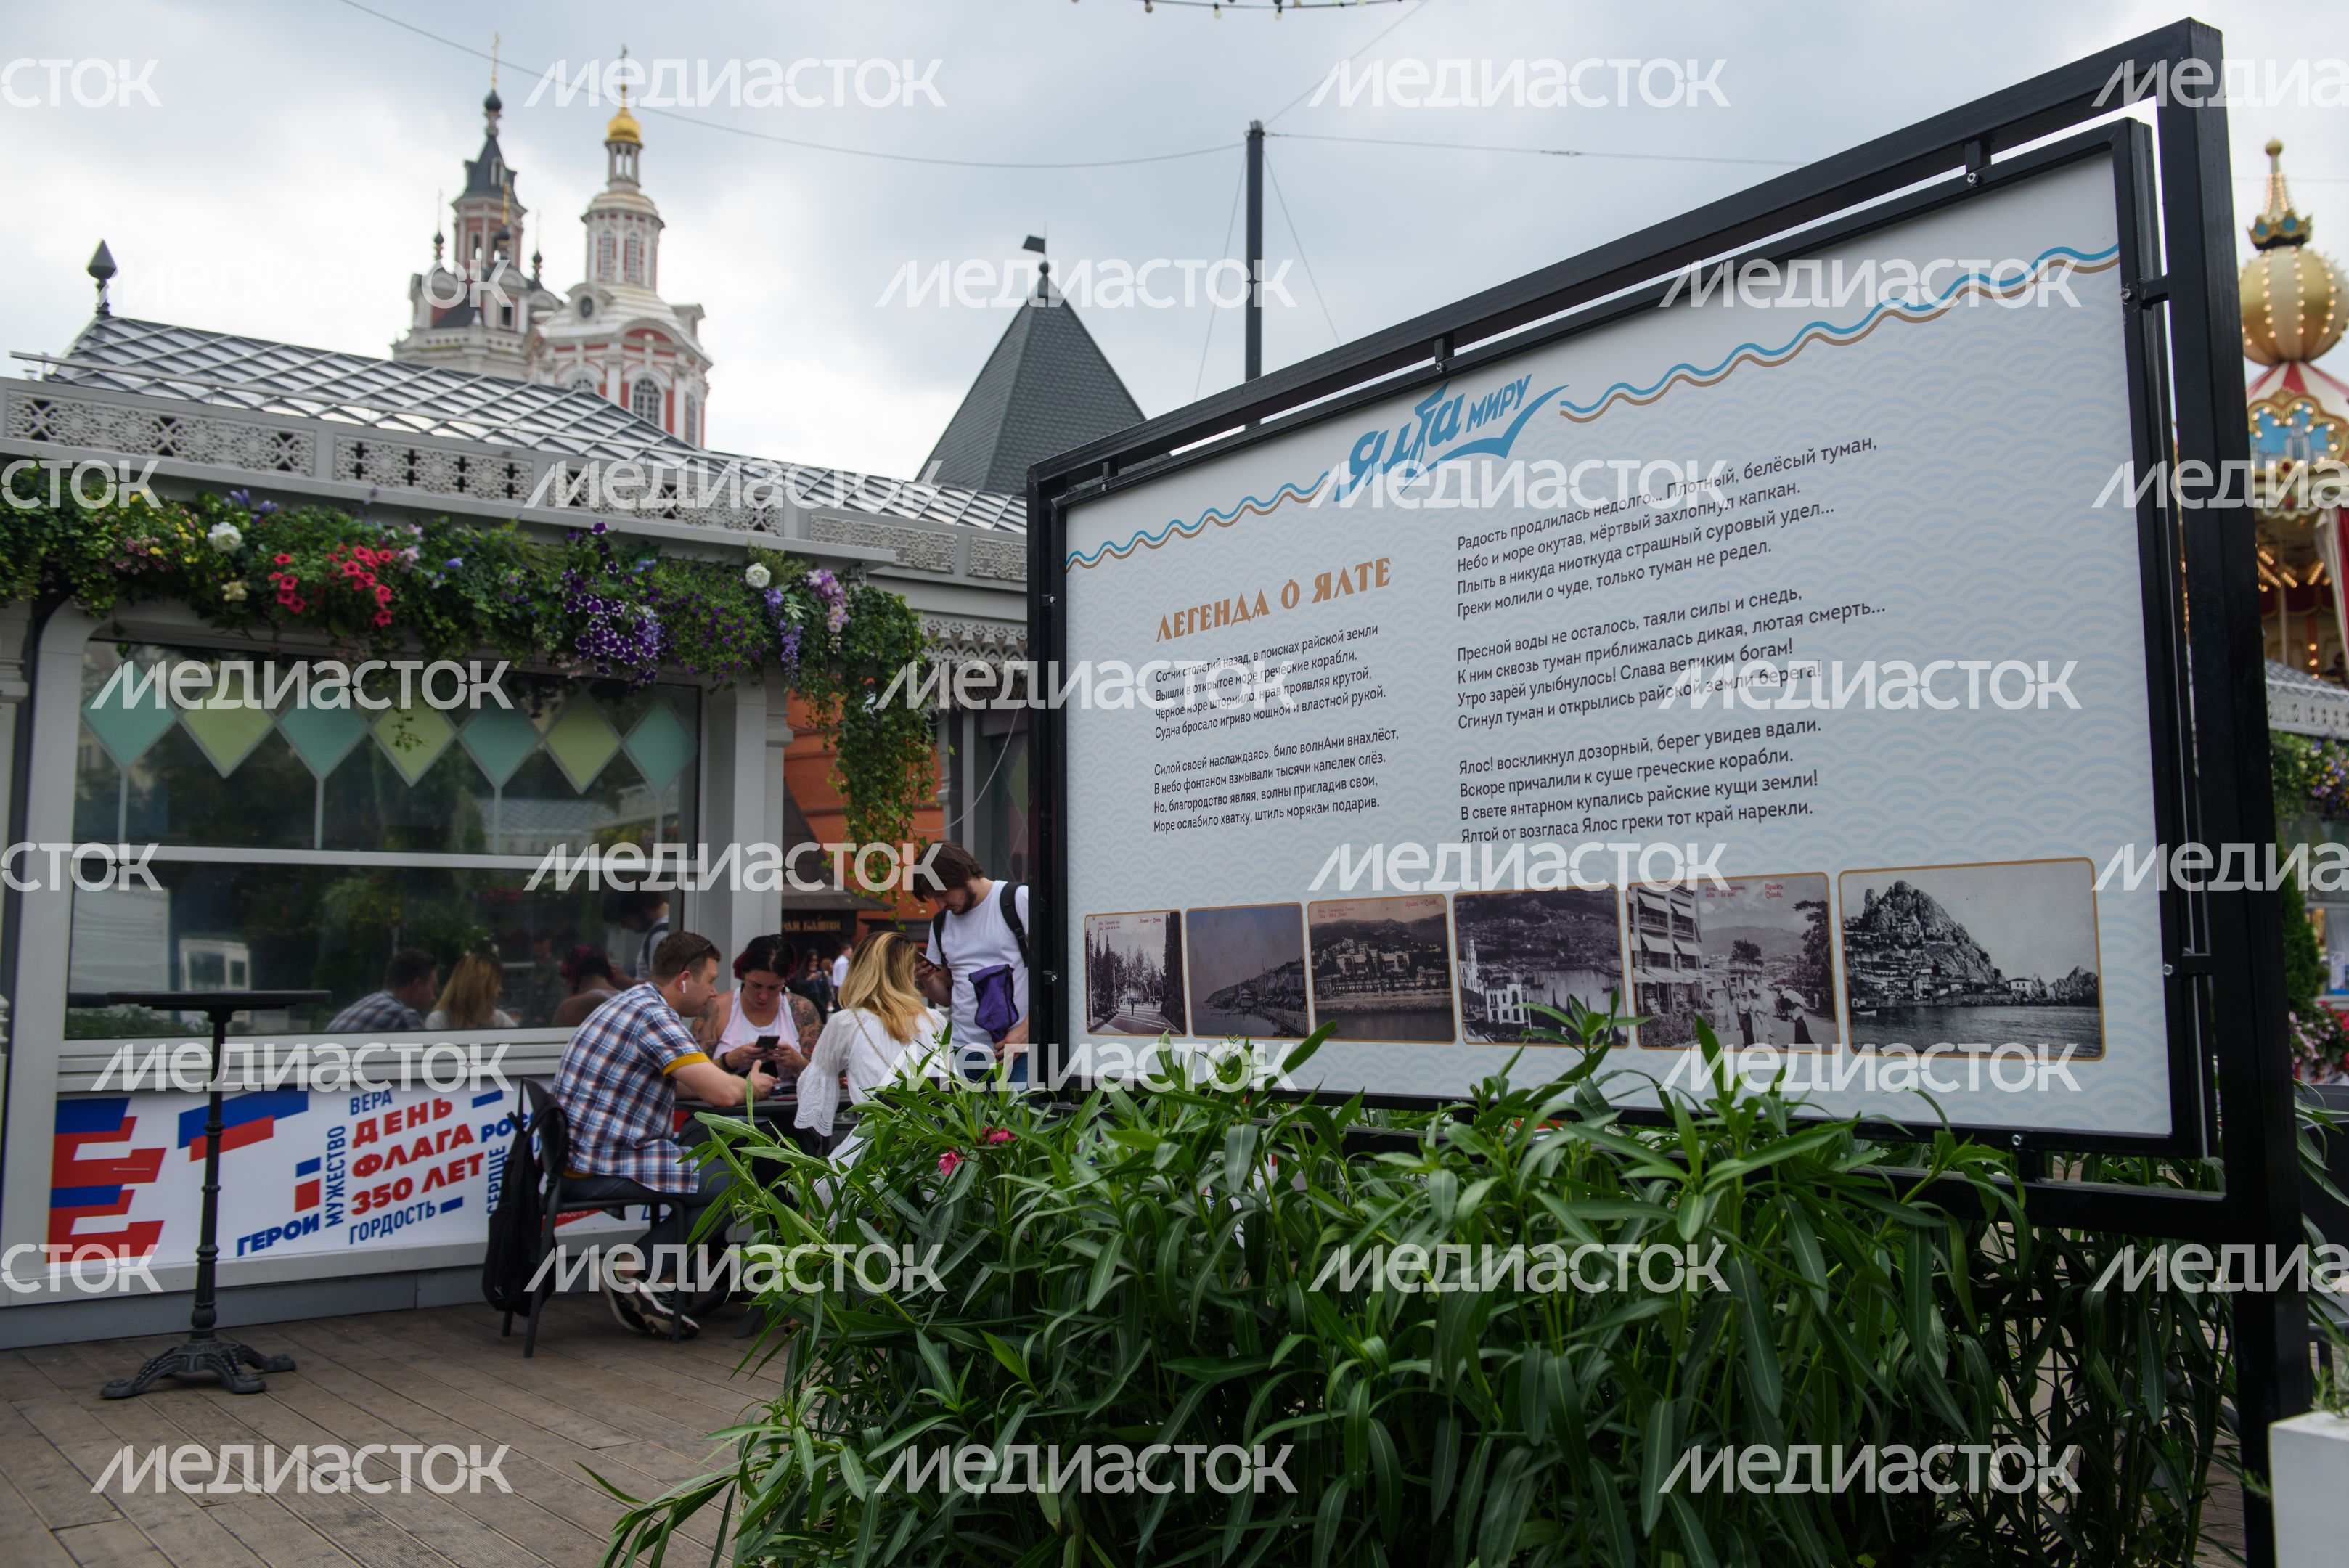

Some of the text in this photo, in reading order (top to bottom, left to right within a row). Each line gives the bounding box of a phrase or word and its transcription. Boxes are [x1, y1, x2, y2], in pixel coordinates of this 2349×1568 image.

[1458, 529, 1508, 551] Радость
[1511, 509, 1590, 540] продлилась
[1744, 447, 1815, 480] белёсый
[1820, 437, 1876, 465] туман,
[1458, 553, 1489, 573] Небо
[1503, 545, 1534, 563] море
[1537, 534, 1585, 555] окутав,
[1590, 513, 1650, 542] мёртвый
[1739, 482, 1800, 507] капкан.
[1458, 503, 1834, 595] Плыть никуда ниоткуда страшный суровый удел...
[1156, 557, 1392, 642] ЛЕГЕНДА О ЯЛТЕ
[1458, 541, 1771, 621] Греки молили чуде, только туман не редел.
[1458, 589, 1802, 665] Пресной воды не осталось, таяли силы снедь,
[1469, 603, 1885, 682] ним сквозь туман приближалась дикая, лютая смерть...
[1155, 687, 1185, 701] Вышли
[1311, 649, 1357, 671] корабли.
[1156, 669, 1181, 683] Сотни
[1260, 642, 1299, 660] поисках
[1302, 629, 1344, 655] райской
[1346, 625, 1378, 641] земли
[1457, 691, 1487, 709] Утро
[1489, 682, 1526, 704] зарёй
[1529, 666, 1616, 700] улыбнулось!
[1620, 663, 1666, 680] Слава
[1739, 637, 1792, 661] богам!
[1283, 677, 1330, 698] проявляя
[1333, 666, 1371, 689] крутой,
[1155, 685, 1386, 741] Судна бросало игриво мощной властной рукой.
[1458, 713, 1503, 730] Сгинул
[1506, 706, 1543, 726] туман
[1558, 693, 1635, 716] открылись
[1154, 727, 1399, 776] Силой своей наслаждаясь, било волнАми внахлёст,
[1161, 750, 1386, 794] небо фонтаном взмывали тысячи капелек слёз.
[1459, 719, 1821, 775] Ялос! воскликнул дозорный, берег увидев вдали.
[1460, 746, 1793, 799] Вскоре причалили суше греческие корабли.
[1153, 776, 1378, 814] Но, благородство являя, волны пригладив свои,
[1153, 797, 1379, 835] Море ослабило хватку, штиль морякам подарив.
[1472, 769, 1818, 820] свете янтарном купались райские кущи земли!
[1461, 802, 1813, 844] Ялтой от возгласа Ялос греки тот край нарекли.
[350, 1090, 393, 1116] ВЕРА
[352, 1097, 453, 1149] ДЕНЬ
[325, 1126, 346, 1228] МУЖЕСТВО
[351, 1124, 474, 1177] ФЛАГА
[351, 1152, 484, 1216] 350 ЛЕТ
[237, 1213, 319, 1257] ГЕРОИ
[349, 1200, 436, 1245] ГОРДОСТЬ
